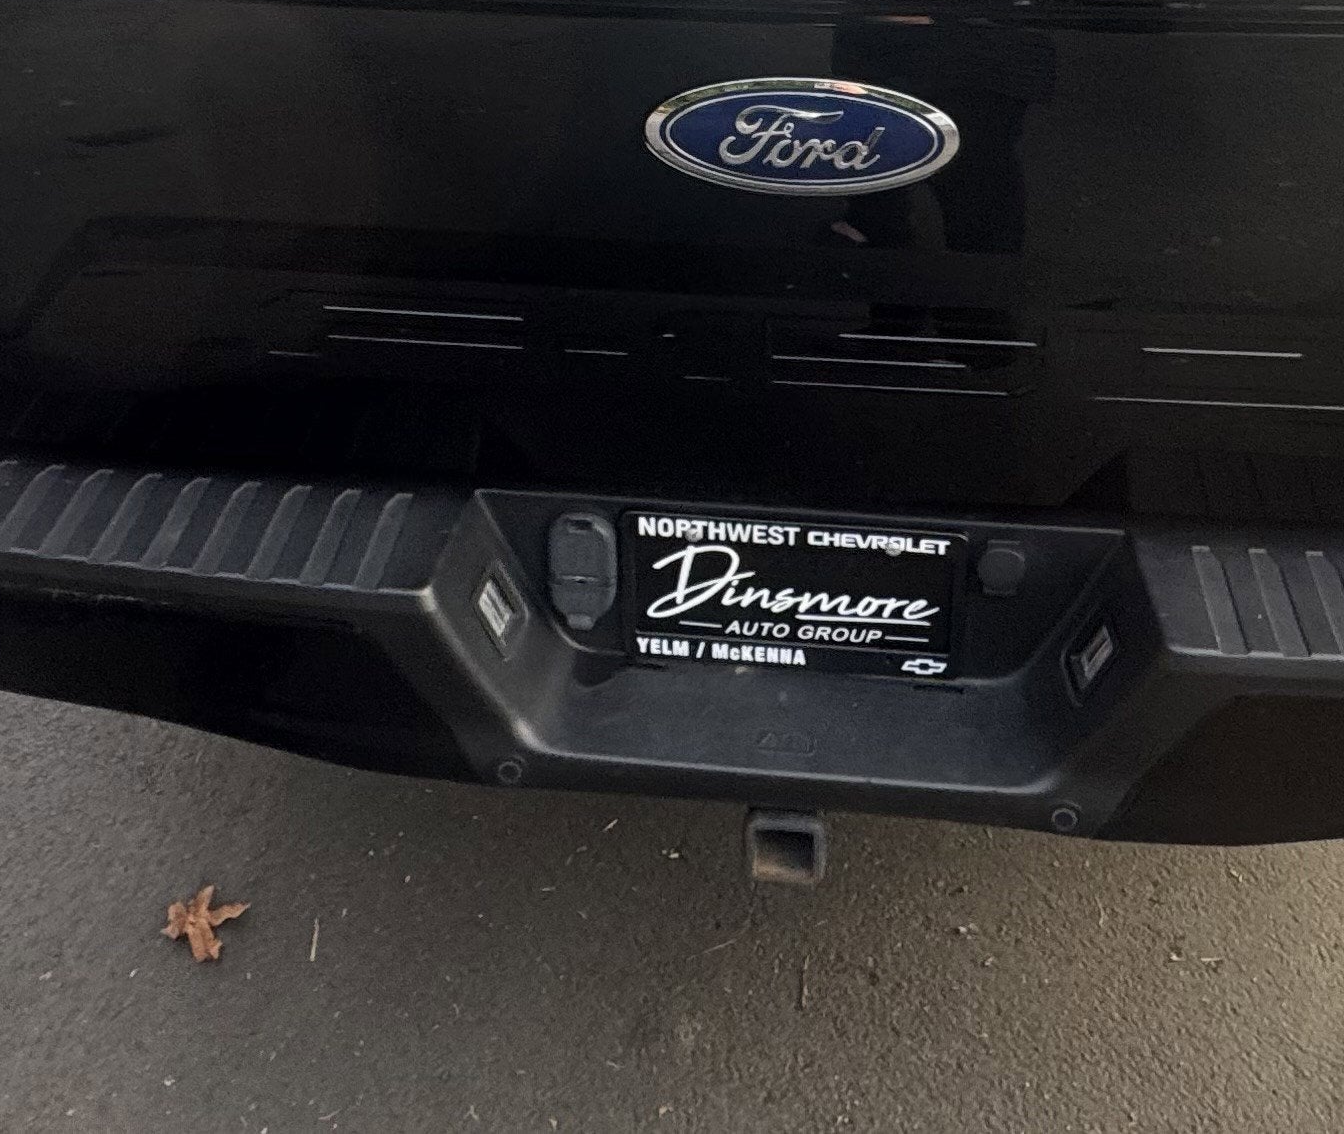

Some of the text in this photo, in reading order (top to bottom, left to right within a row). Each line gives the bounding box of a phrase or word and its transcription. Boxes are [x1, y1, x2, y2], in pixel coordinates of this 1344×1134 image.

[718, 105, 885, 169] Ford
[638, 516, 951, 556] NORTHWEST CHEVROLET
[647, 544, 940, 621] Dinsmore
[636, 637, 690, 656] YELM
[712, 640, 806, 666] McKENNA
[725, 620, 883, 643] AUTO GROUP
